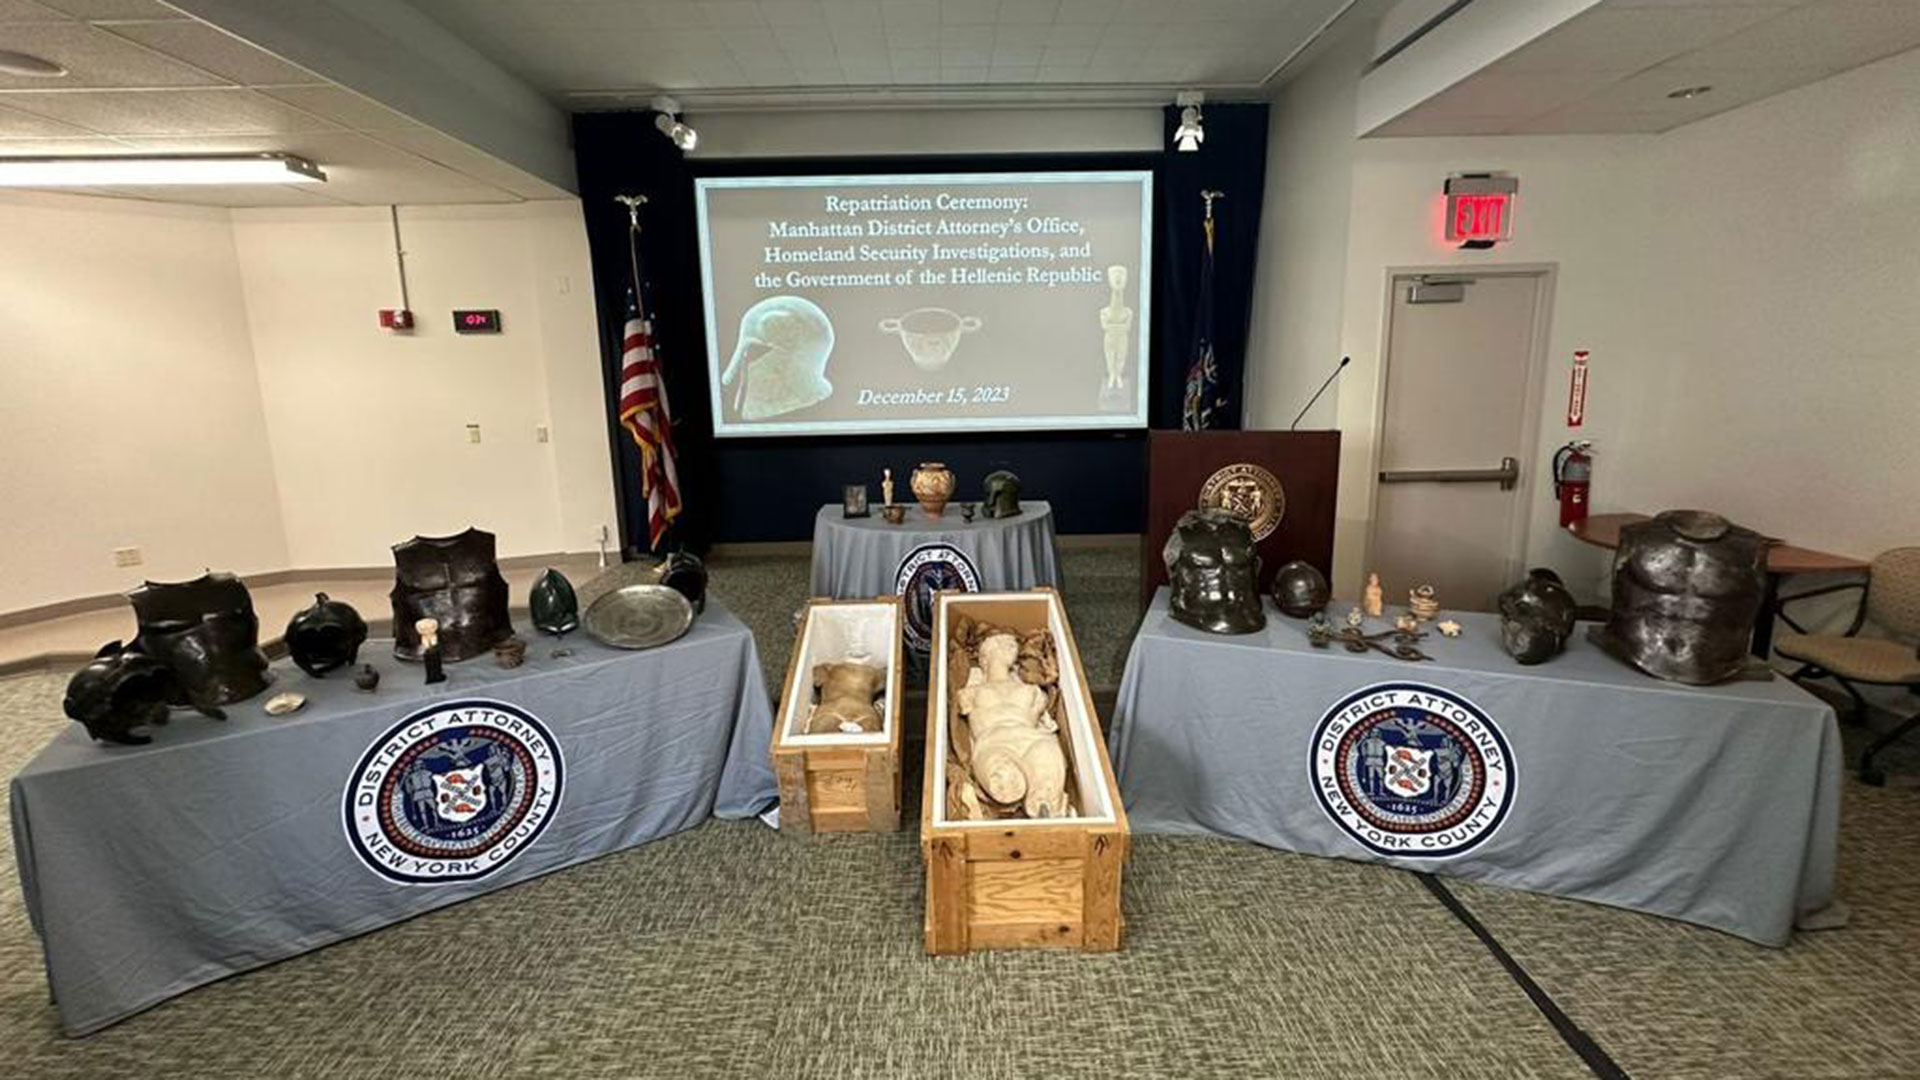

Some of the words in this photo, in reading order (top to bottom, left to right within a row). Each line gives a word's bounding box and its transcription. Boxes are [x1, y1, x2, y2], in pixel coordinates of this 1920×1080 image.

[825, 195, 931, 216] Repatriation
[936, 193, 1028, 213] Ceremony:
[769, 221, 863, 238] Manhattan
[868, 219, 931, 236] District
[1027, 216, 1084, 236] Office,
[1457, 198, 1504, 236] EXIT
[764, 246, 855, 263] Homeland
[860, 244, 928, 264] Security
[932, 242, 1054, 263] Investigations,
[1060, 241, 1090, 258] and
[754, 272, 782, 288] the
[786, 271, 891, 288] Government
[895, 269, 914, 285] of
[919, 269, 945, 284] the
[951, 267, 1023, 284] Hellenic
[1027, 266, 1102, 287] Republic
[857, 388, 943, 405] December
[946, 387, 967, 405] 15,
[972, 386, 1010, 403] 2023
[899, 551, 932, 594] ISTRICT
[1322, 692, 1399, 752] DISTRICT
[1408, 693, 1503, 772] ATTORNEY
[358, 717, 437, 806] DISTRICT
[449, 710, 550, 762] ATTORNEY
[1322, 775, 1353, 817] NEW
[1354, 818, 1411, 849] YORK
[1421, 796, 1497, 849] COUNTY
[1392, 803, 1418, 814] 1625
[366, 831, 409, 868] NEW
[413, 860, 480, 874] YORK
[489, 786, 551, 862] COUNTY
[451, 827, 479, 839] 1625
